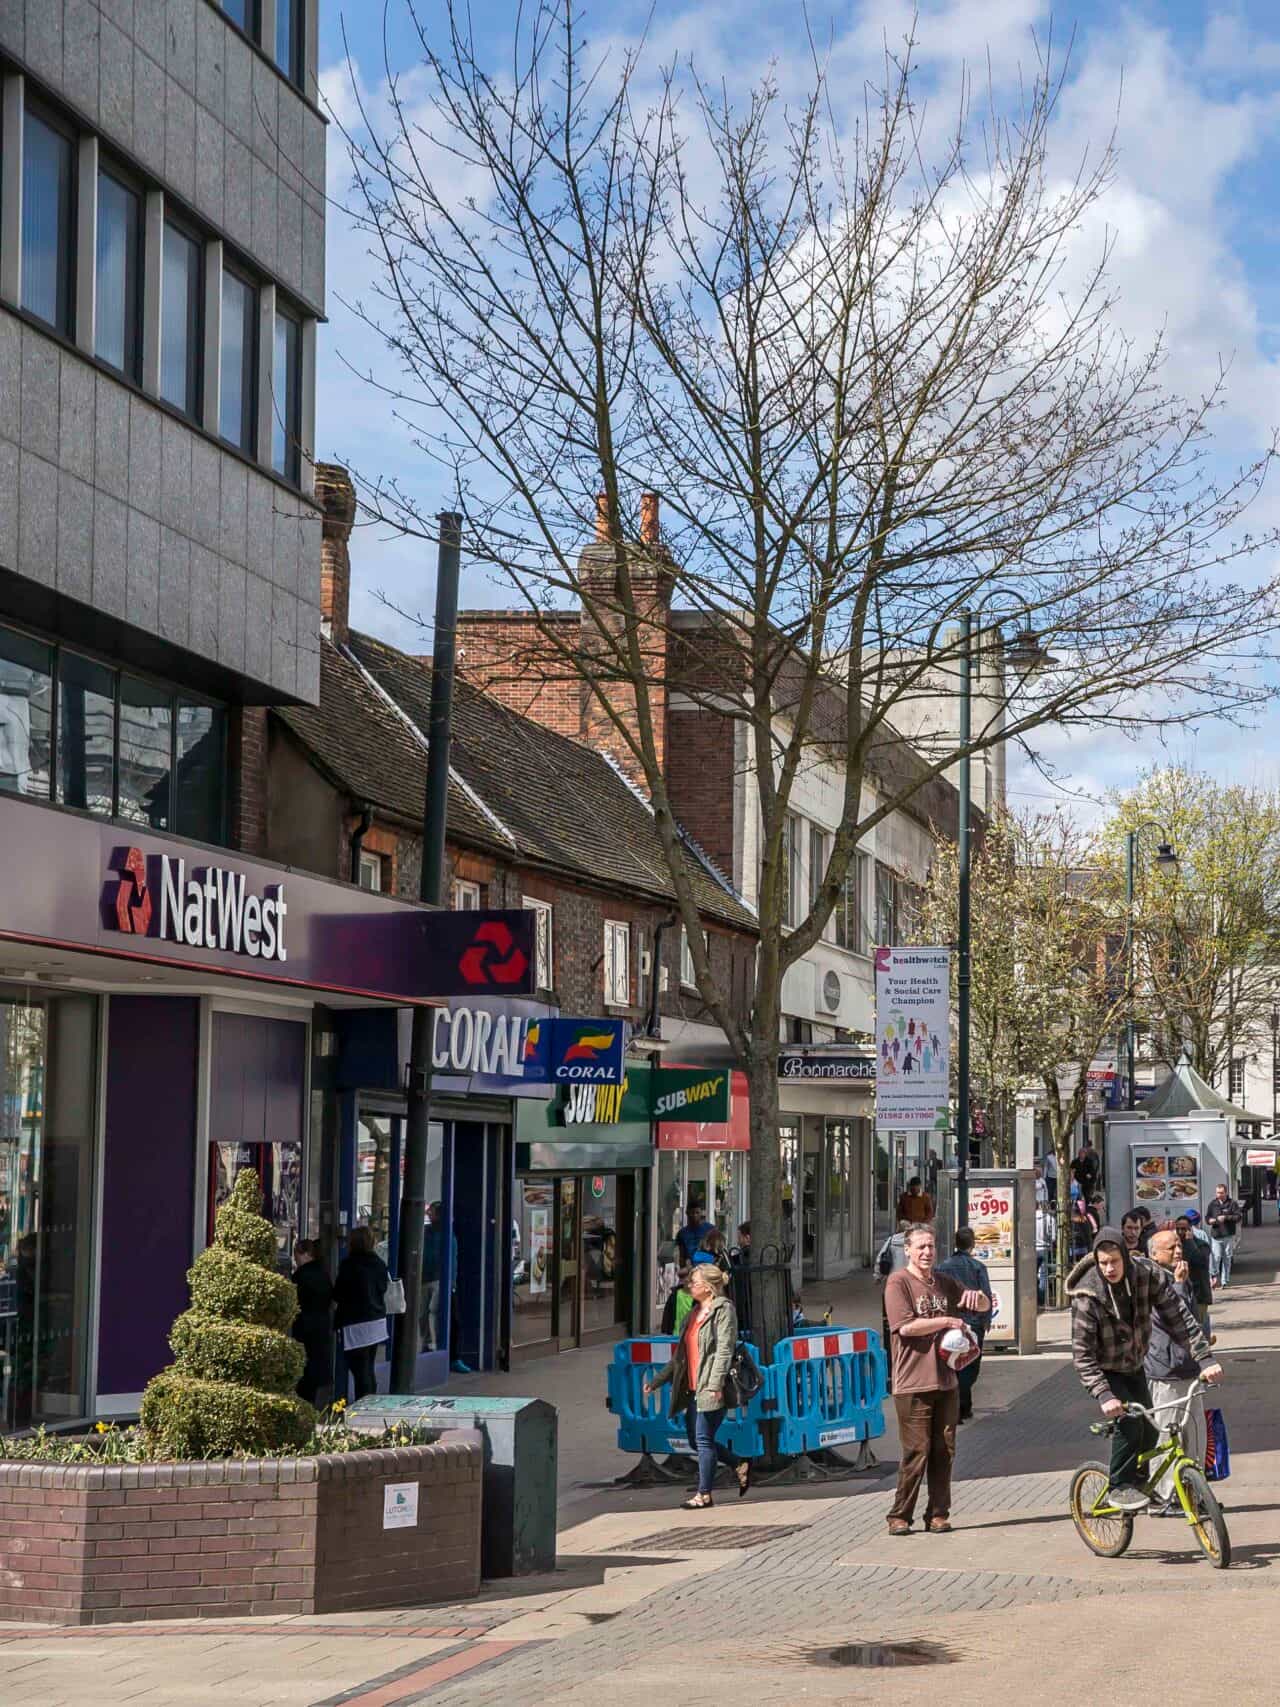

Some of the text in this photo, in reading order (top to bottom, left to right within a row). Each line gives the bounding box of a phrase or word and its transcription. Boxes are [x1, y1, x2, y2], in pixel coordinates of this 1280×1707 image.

[160, 854, 287, 962] NatWest
[432, 1007, 525, 1077] CORAL
[556, 1066, 617, 1079] CORAL
[564, 1078, 629, 1124] SUBWAY
[654, 1076, 724, 1116] SUBWAY
[980, 1199, 1009, 1216] 99p
